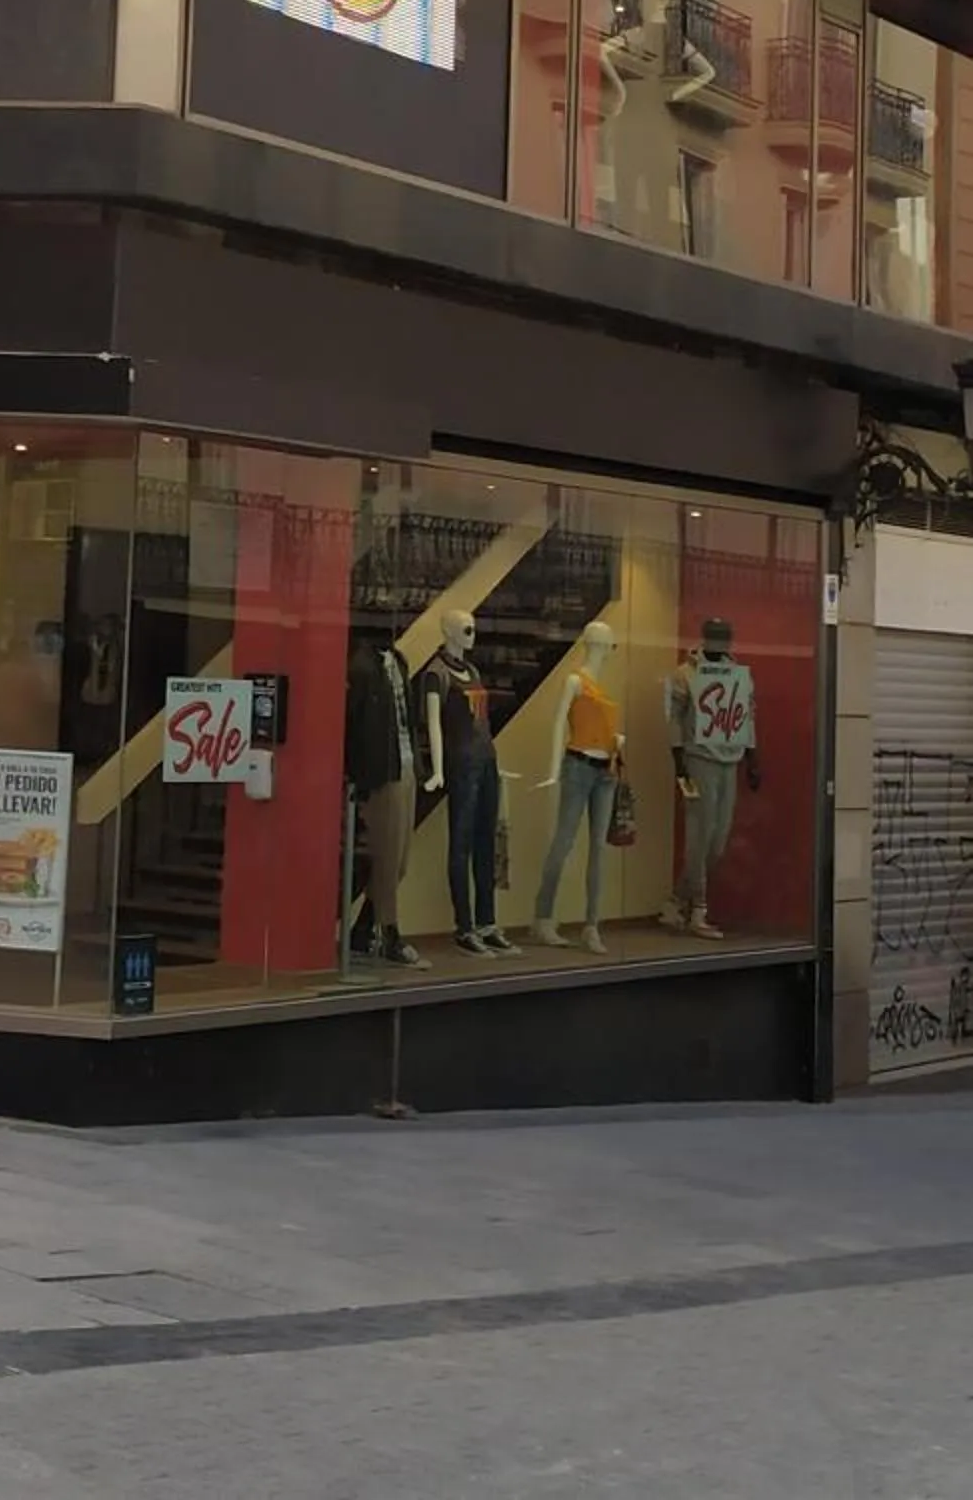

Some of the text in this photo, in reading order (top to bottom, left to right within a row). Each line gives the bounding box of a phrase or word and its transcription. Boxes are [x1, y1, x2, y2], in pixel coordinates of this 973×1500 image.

[168, 698, 247, 778] Sale
[699, 680, 748, 742] Sale
[6, 773, 58, 793] PEDIDO
